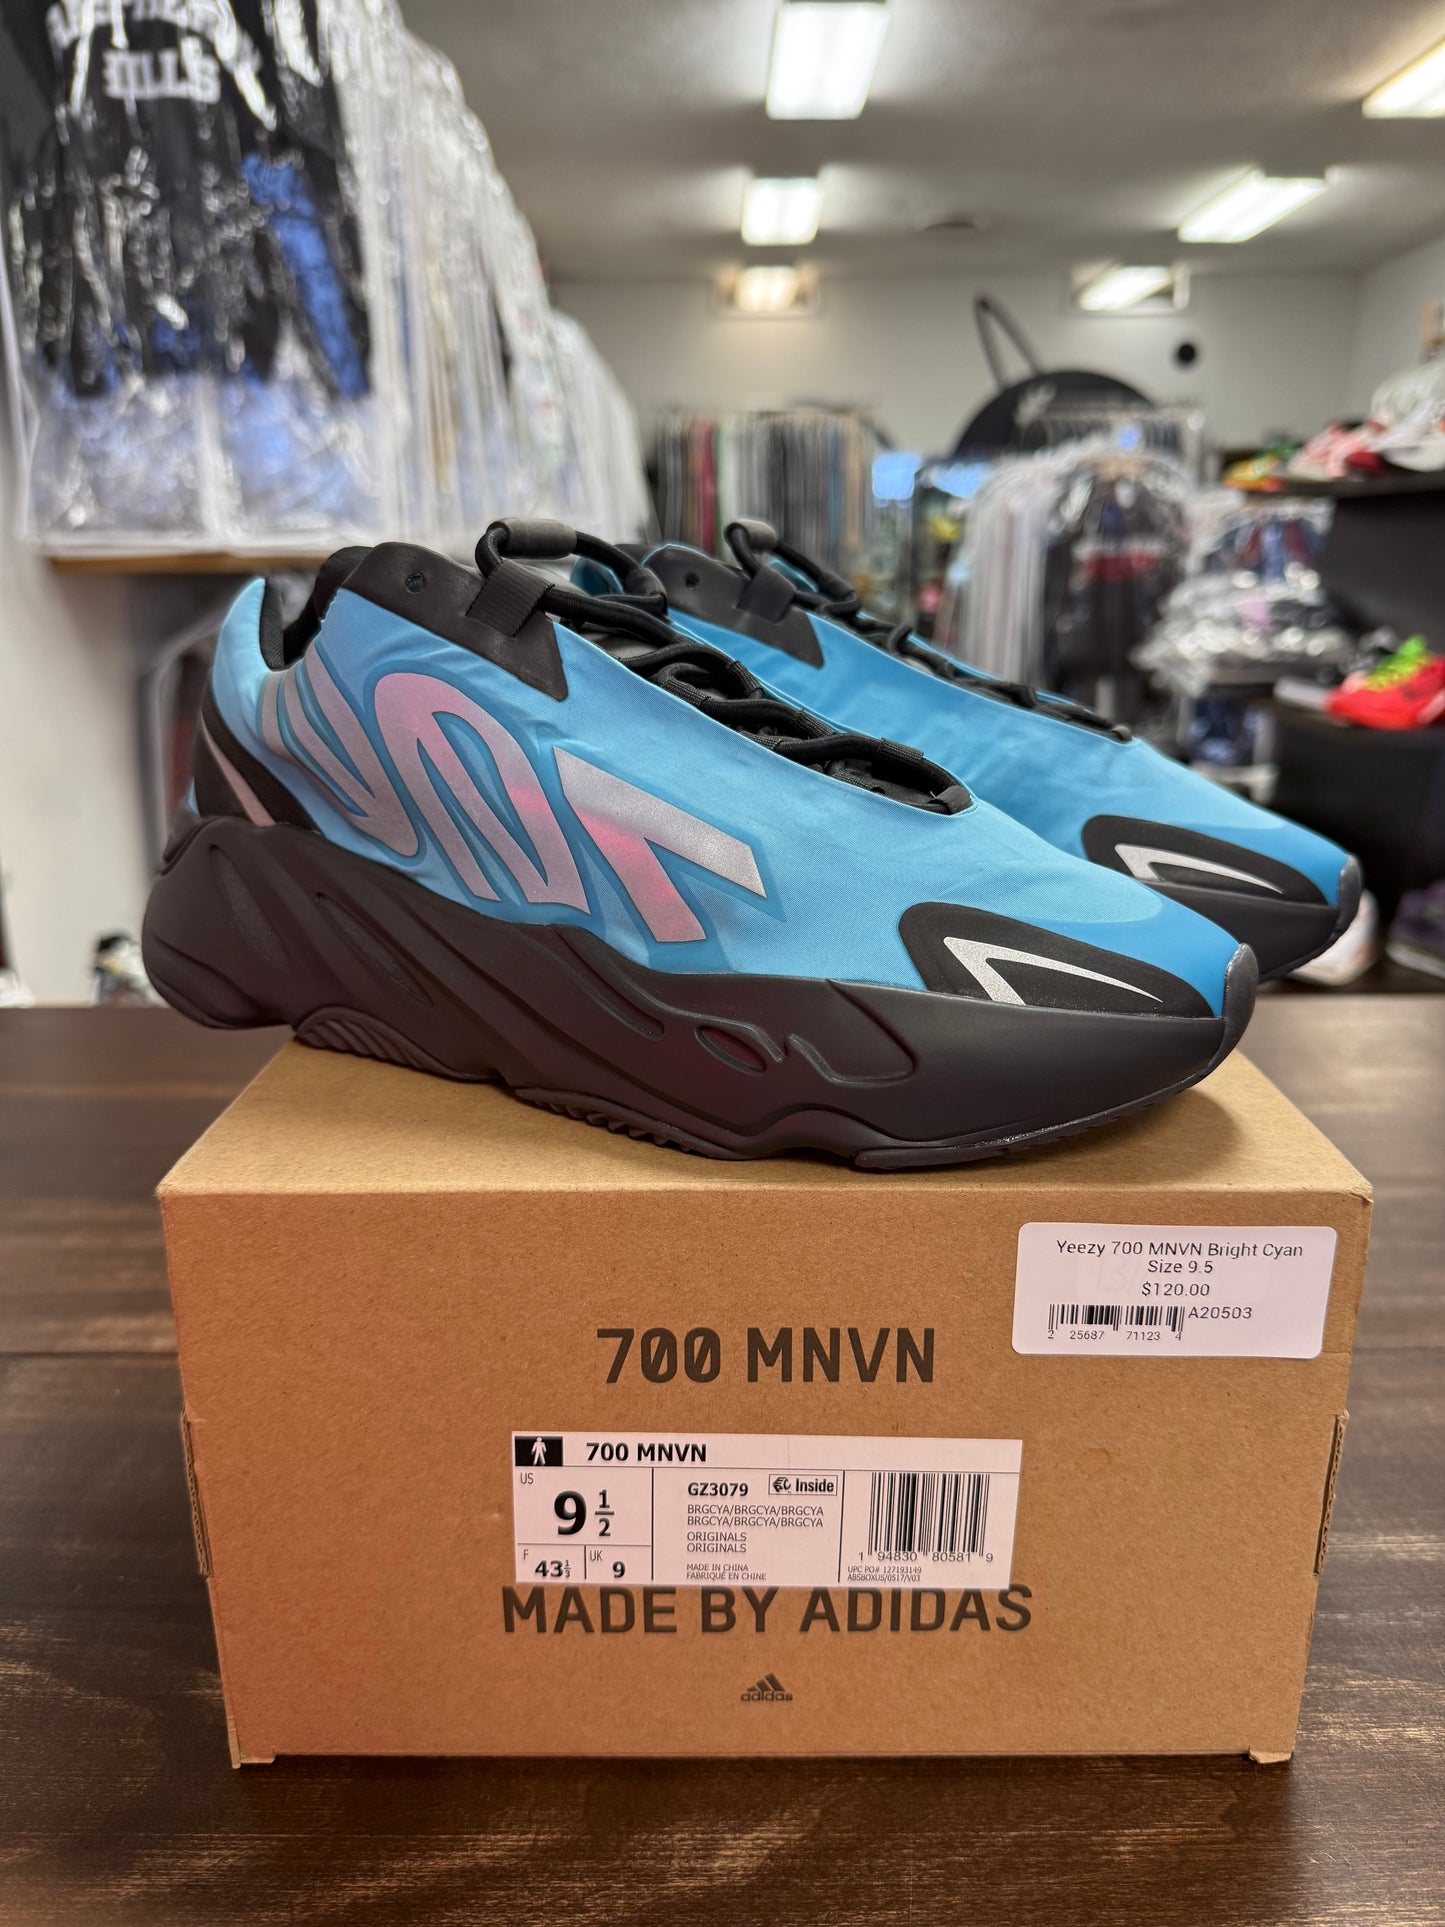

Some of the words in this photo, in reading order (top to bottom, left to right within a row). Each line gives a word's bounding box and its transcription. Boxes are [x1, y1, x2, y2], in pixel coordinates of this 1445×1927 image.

[1056, 1240, 1106, 1258] Yeezy
[1111, 1241, 1143, 1256] 700
[1148, 1242, 1202, 1257] MNVN
[1207, 1243, 1258, 1260] Bright
[1262, 1243, 1303, 1260] Cyan
[1147, 1260, 1183, 1274] Size
[1188, 1261, 1213, 1275] 9.5
[1141, 1281, 1210, 1298] $120.00
[1187, 1306, 1253, 1320] A20503
[1047, 1330, 1055, 1340] 2
[1069, 1330, 1105, 1341] 25687
[1126, 1331, 1161, 1341] 71123
[1174, 1331, 1183, 1342] 4
[596, 1327, 721, 1384] 700
[747, 1327, 935, 1384] MNVN
[586, 1442, 629, 1462] 700
[637, 1443, 707, 1463] MNVN
[520, 1472, 534, 1485] US
[687, 1482, 749, 1497] GZ3079
[795, 1478, 834, 1493] Inside
[554, 1490, 587, 1535] 9
[687, 1504, 824, 1516] BRGCYA/BRGCYA/BRGCYA
[687, 1516, 823, 1528] BRGCYA/BRGCYA/BRGCYA
[687, 1531, 747, 1542] ORIGINALS
[687, 1543, 747, 1553] ORIGINALS
[523, 1549, 529, 1560] F
[589, 1550, 603, 1562] UK
[877, 1552, 918, 1562] 94830
[932, 1552, 971, 1562] 80581
[985, 1553, 993, 1563] 9
[612, 1561, 626, 1578] 9
[723, 1564, 748, 1572] CHINA
[865, 1566, 880, 1574] PO#
[728, 1572, 739, 1580] EN
[741, 1572, 766, 1581] CHINE
[502, 1586, 677, 1633] MADE
[701, 1587, 779, 1633] BY
[799, 1583, 1032, 1632] ADIDAS
[740, 1690, 793, 1701] adidas
